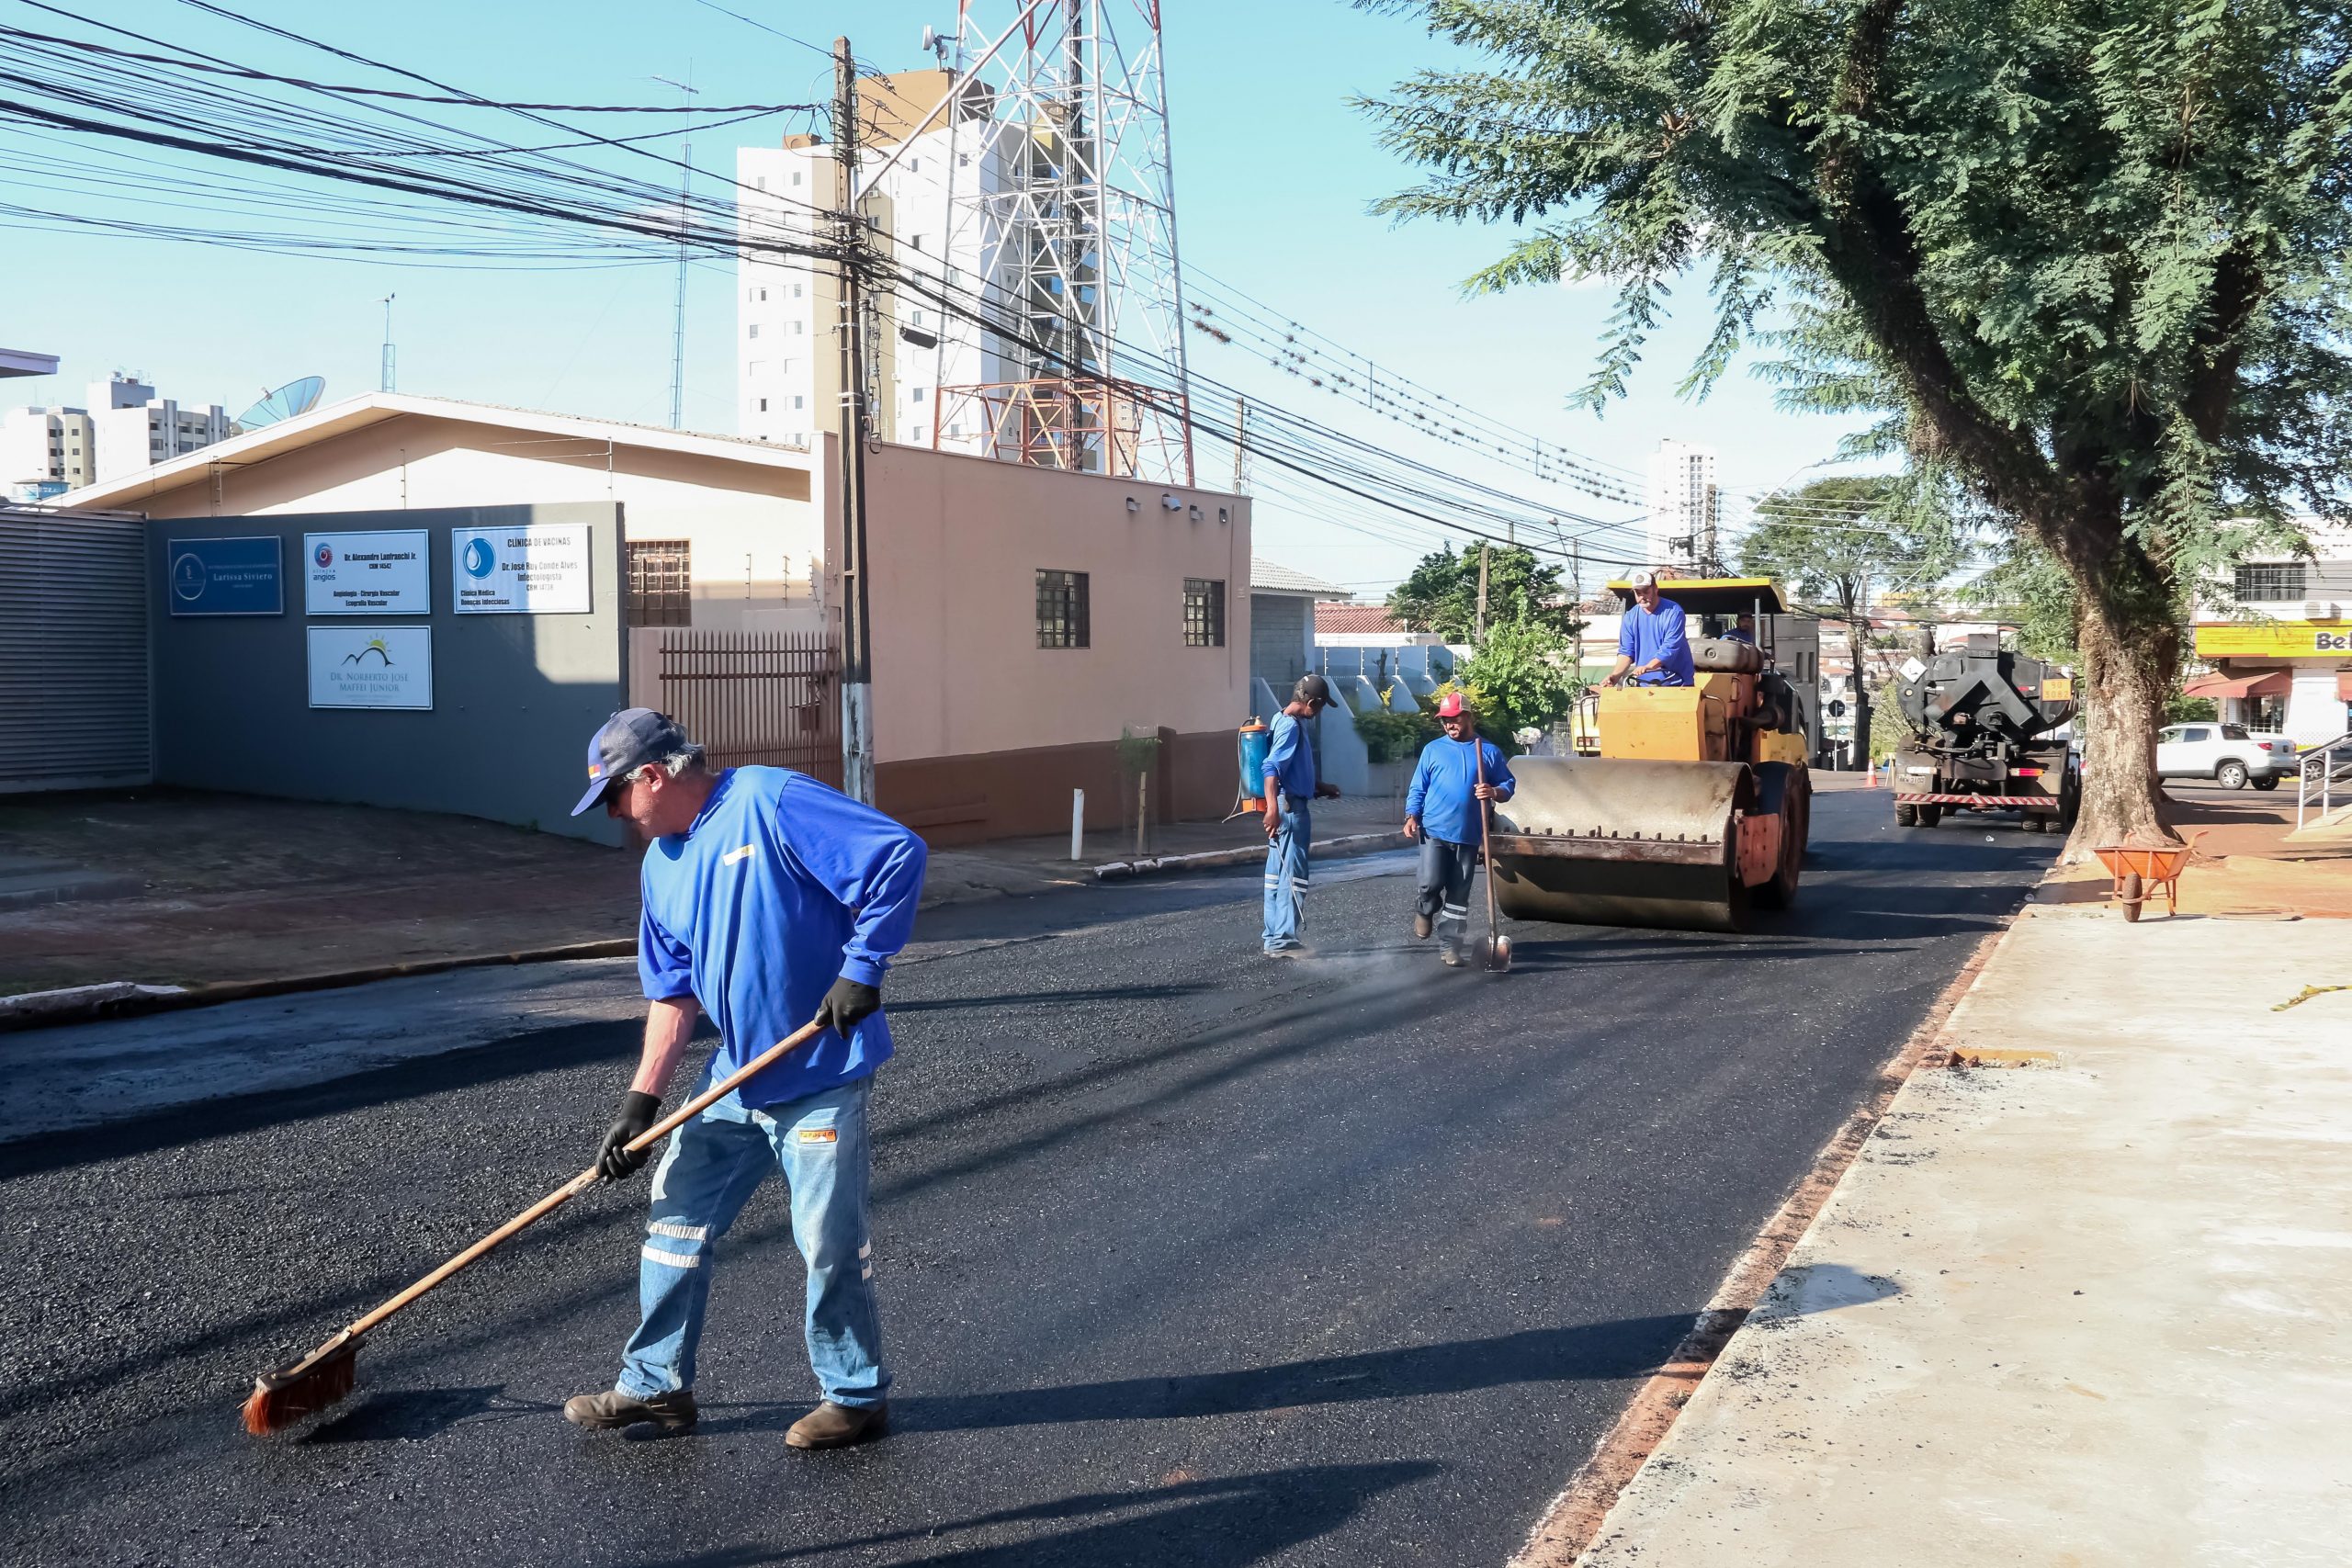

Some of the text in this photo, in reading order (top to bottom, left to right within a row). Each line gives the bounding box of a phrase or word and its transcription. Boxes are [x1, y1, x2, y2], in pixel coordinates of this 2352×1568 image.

[507, 537, 571, 547] CLÍNICA DE VACINAS
[352, 553, 379, 561] Alexandre
[511, 562, 525, 570] José
[539, 561, 559, 570] Conde
[560, 560, 578, 569] Alves
[213, 572, 273, 581] Larissa Siviero
[313, 574, 336, 582] angios
[517, 573, 562, 581] Infectologista
